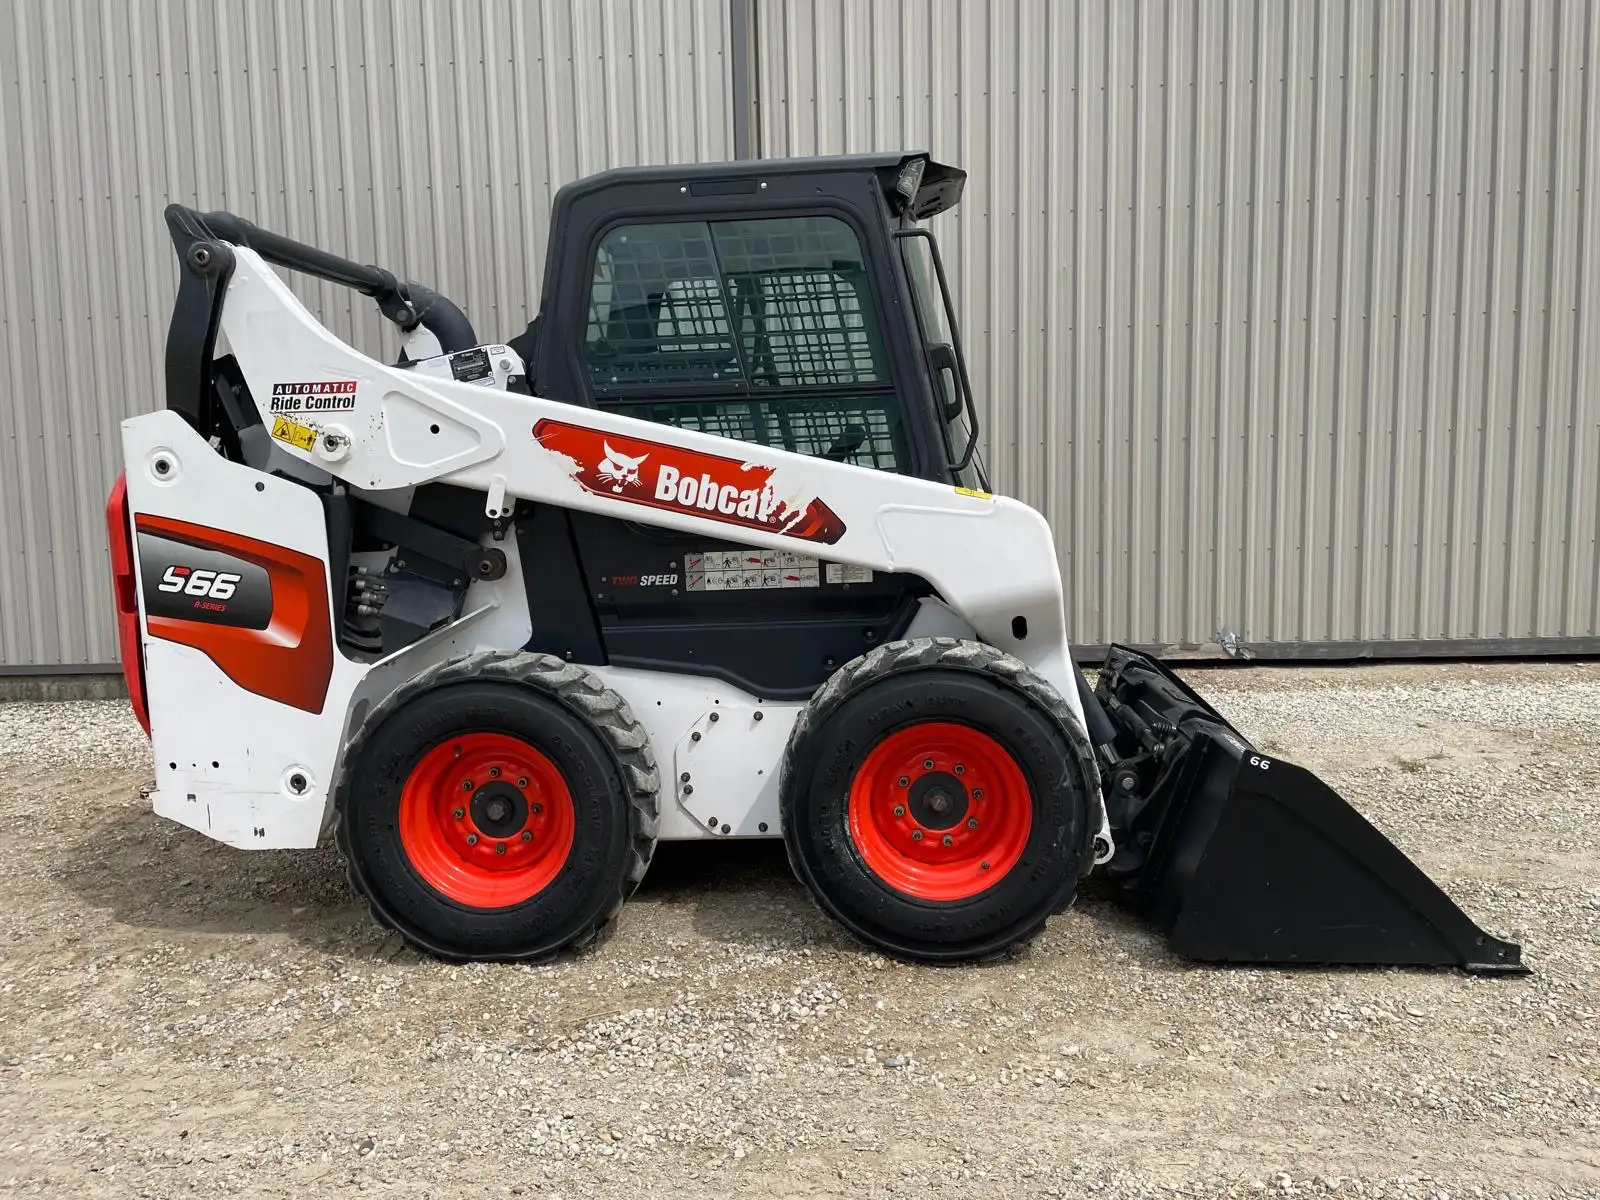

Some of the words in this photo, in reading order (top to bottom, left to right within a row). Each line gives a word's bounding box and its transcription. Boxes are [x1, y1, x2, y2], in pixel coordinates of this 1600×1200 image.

[275, 382, 354, 394] AUTOMATIC
[271, 396, 301, 411] Ride
[305, 395, 355, 410] Control
[654, 464, 774, 523] Bobcat
[157, 566, 242, 600] S66
[611, 576, 639, 586] TWO
[640, 574, 678, 586] SPEED
[1250, 756, 1271, 770] 66
